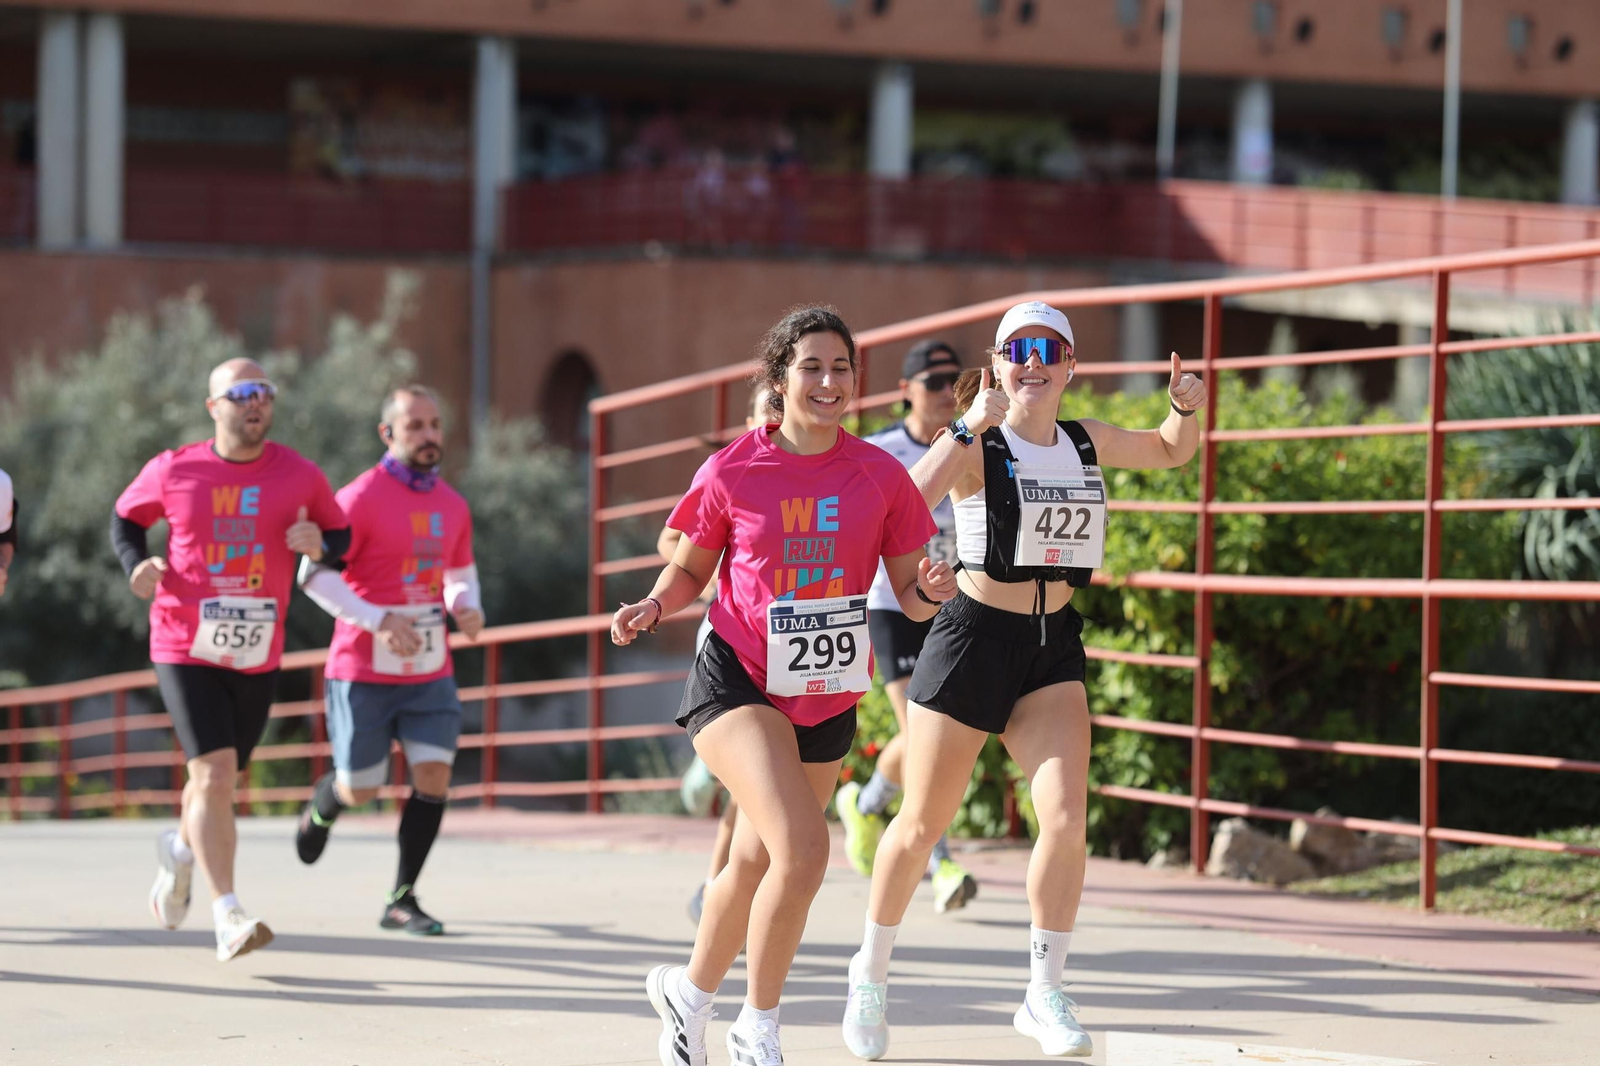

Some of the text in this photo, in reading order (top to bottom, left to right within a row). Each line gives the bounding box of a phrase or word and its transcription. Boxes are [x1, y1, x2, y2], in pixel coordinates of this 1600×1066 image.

[212, 486, 260, 515] WE
[1024, 488, 1063, 500] UMA
[780, 496, 839, 532] WE
[1035, 507, 1091, 540] 422
[207, 544, 266, 574] UMA
[788, 540, 831, 560] RUN
[1046, 552, 1060, 560] WE
[774, 568, 844, 601] UMA
[207, 608, 240, 619] UMA
[774, 616, 820, 630] UMA
[213, 624, 264, 648] 656
[788, 632, 856, 671] 299
